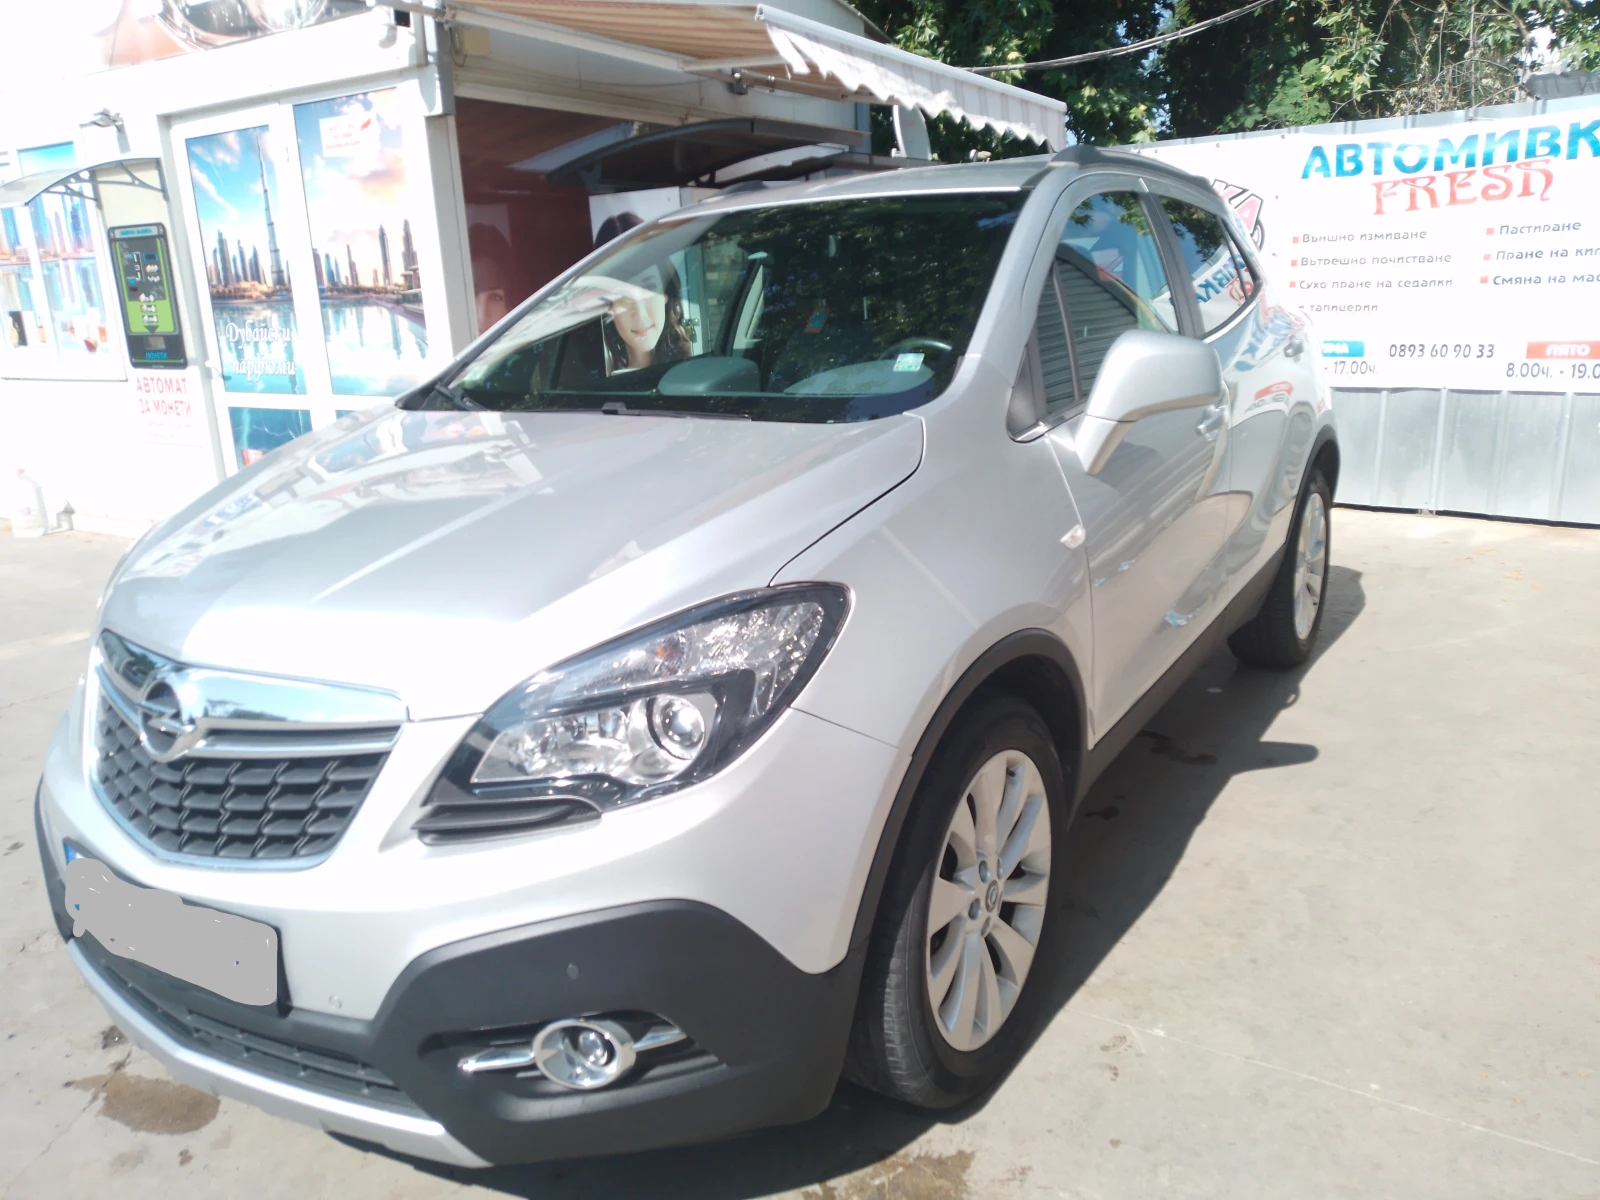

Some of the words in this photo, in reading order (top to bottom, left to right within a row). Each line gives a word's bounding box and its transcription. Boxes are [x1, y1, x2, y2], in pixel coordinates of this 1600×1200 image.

[1301, 121, 1600, 179] АВТОМИВК
[1360, 231, 1427, 241] измиване
[1371, 254, 1452, 264] почистване
[1496, 250, 1544, 260] Пране
[1549, 249, 1569, 258] на
[1299, 280, 1326, 289] Сухо
[1332, 280, 1372, 289] пране
[1376, 280, 1392, 288] на
[1397, 279, 1453, 288] седалки
[1493, 275, 1541, 285] Смяна
[1548, 275, 1566, 284] на
[1310, 304, 1378, 312] тапицерии
[1389, 344, 1425, 358] 0893
[1430, 344, 1448, 358] 60
[1453, 344, 1471, 358] 90
[1476, 344, 1495, 358] 33
[137, 376, 187, 395] АВТОМАТ
[153, 400, 192, 417] МОНЕТИ
